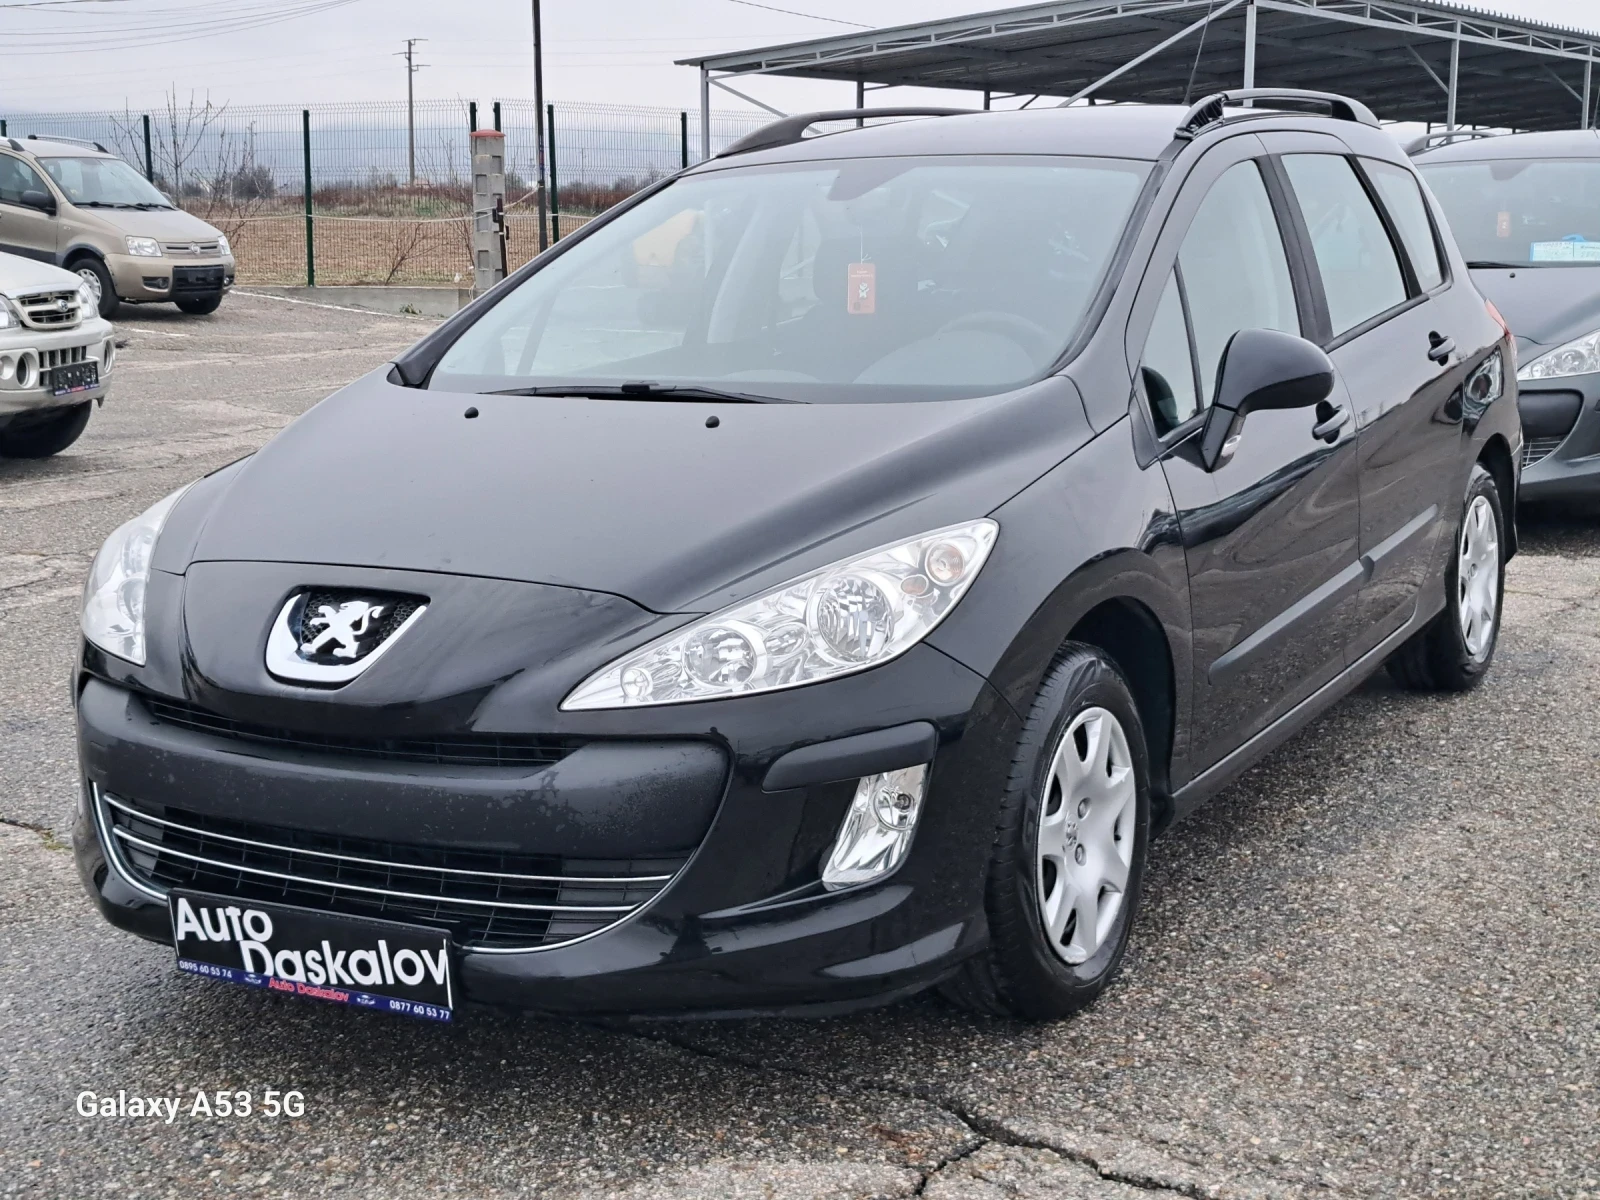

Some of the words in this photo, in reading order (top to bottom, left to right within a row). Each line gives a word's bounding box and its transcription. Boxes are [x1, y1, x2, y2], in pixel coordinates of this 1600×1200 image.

[177, 898, 273, 942] Auto
[179, 960, 198, 972] 0895
[199, 965, 209, 974] 60
[210, 966, 220, 976] 53
[240, 940, 448, 985] Daskalov
[268, 977, 295, 992] Auto
[390, 1000, 411, 1011] 0877
[414, 1005, 424, 1015] 60
[426, 1008, 437, 1017] 53
[439, 1010, 450, 1019] 77
